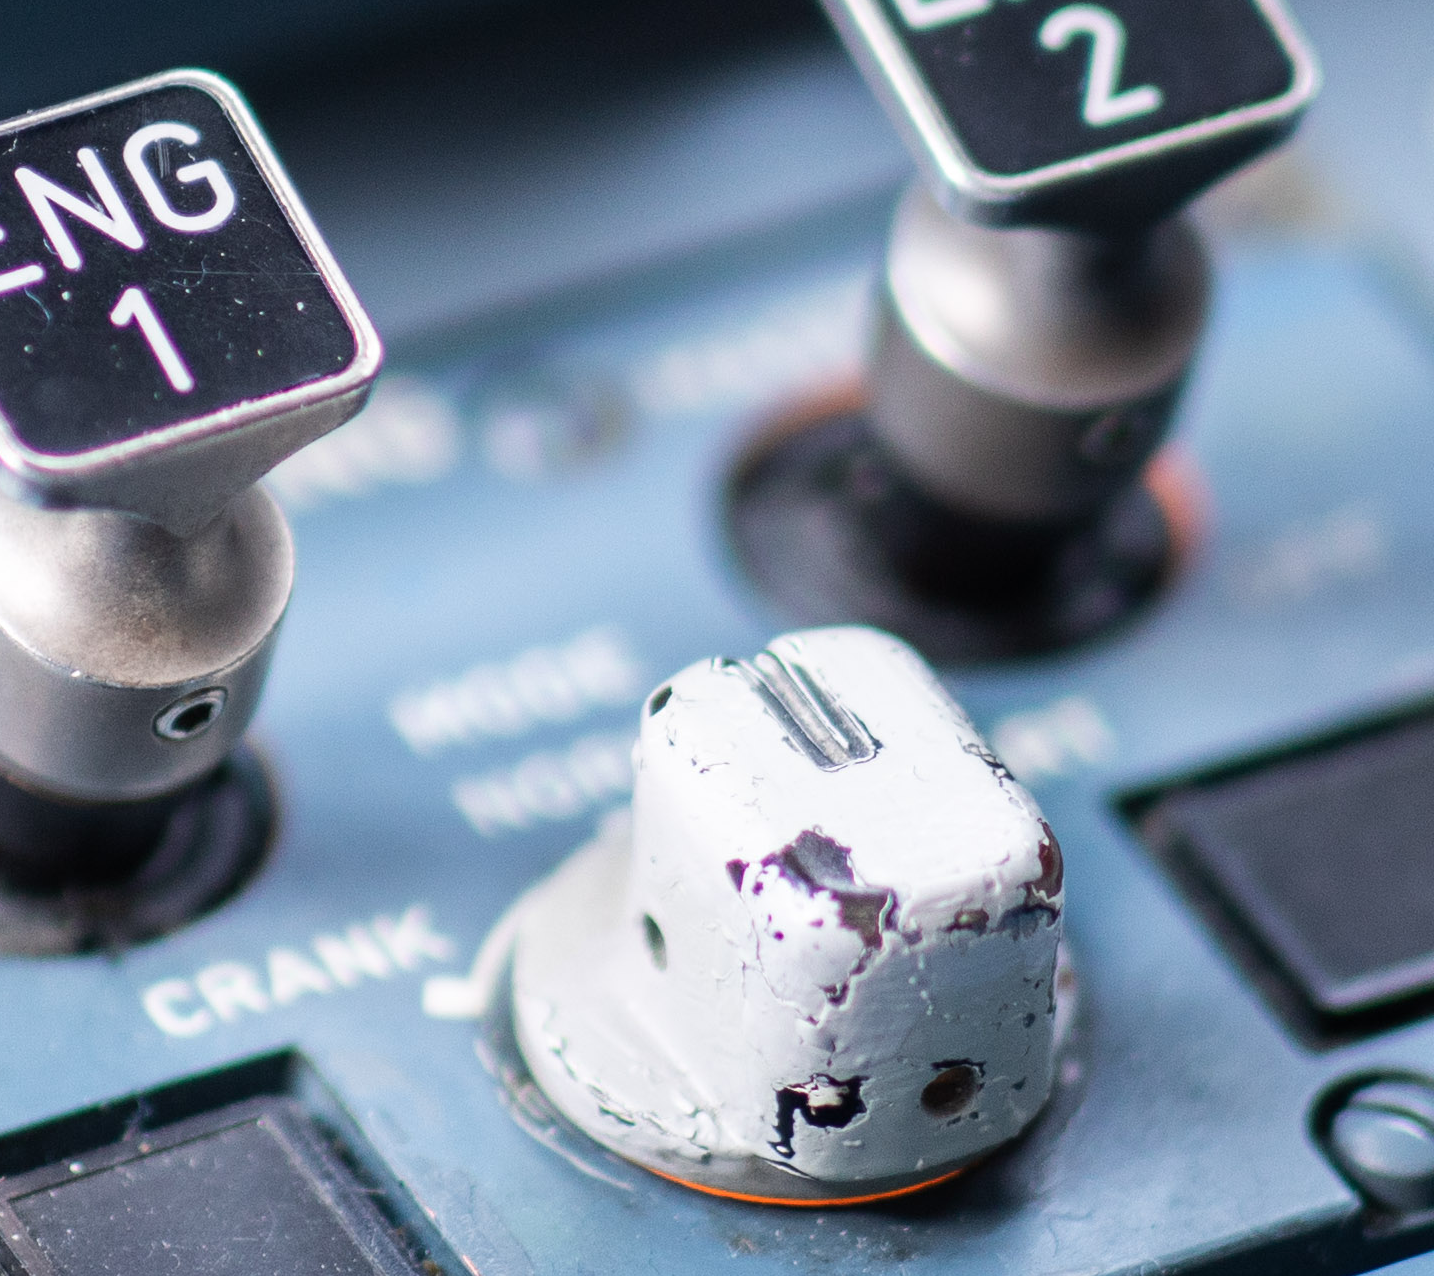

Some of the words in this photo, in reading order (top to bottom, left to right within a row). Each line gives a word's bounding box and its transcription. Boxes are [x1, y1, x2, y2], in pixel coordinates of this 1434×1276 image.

[1038, 2, 1163, 126] 2
[110, 287, 195, 394] 1
[143, 905, 456, 1037] CRANK
